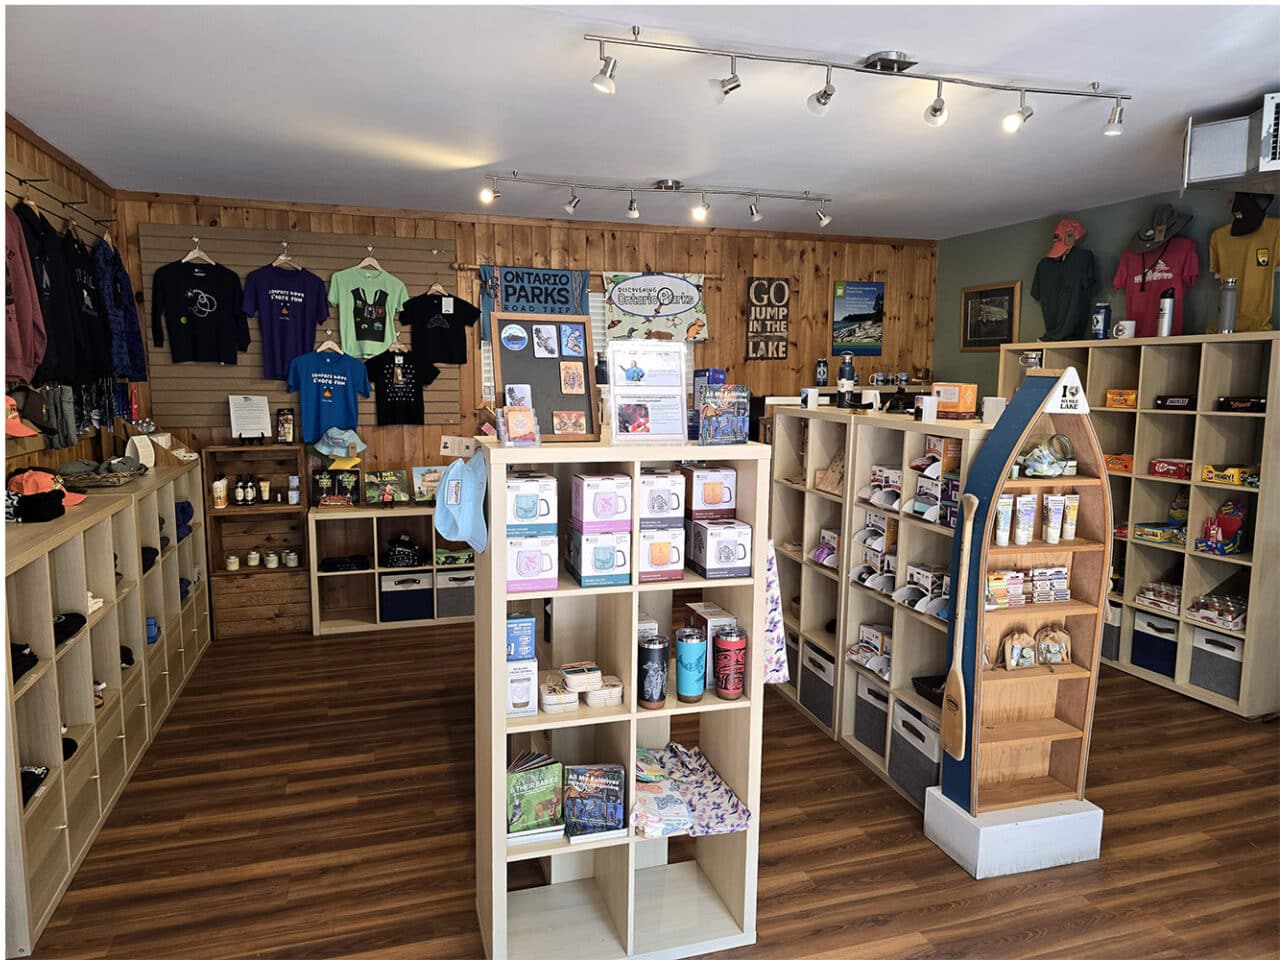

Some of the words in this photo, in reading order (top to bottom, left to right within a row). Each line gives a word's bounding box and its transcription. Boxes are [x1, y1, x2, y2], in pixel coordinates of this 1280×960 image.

[503, 271, 570, 287] ONTARIO
[290, 290, 305, 298] HAVE
[503, 285, 570, 305] PARKS
[617, 292, 658, 306] Ontario
[661, 290, 694, 306] Parks
[749, 280, 790, 307] GO
[503, 304, 535, 313] ROAD
[543, 306, 571, 314] TRIP
[750, 306, 788, 321] JUMP
[749, 321, 761, 333] IN
[765, 321, 787, 332] THE
[748, 342, 787, 359] LAKE
[1062, 385, 1068, 398] I
